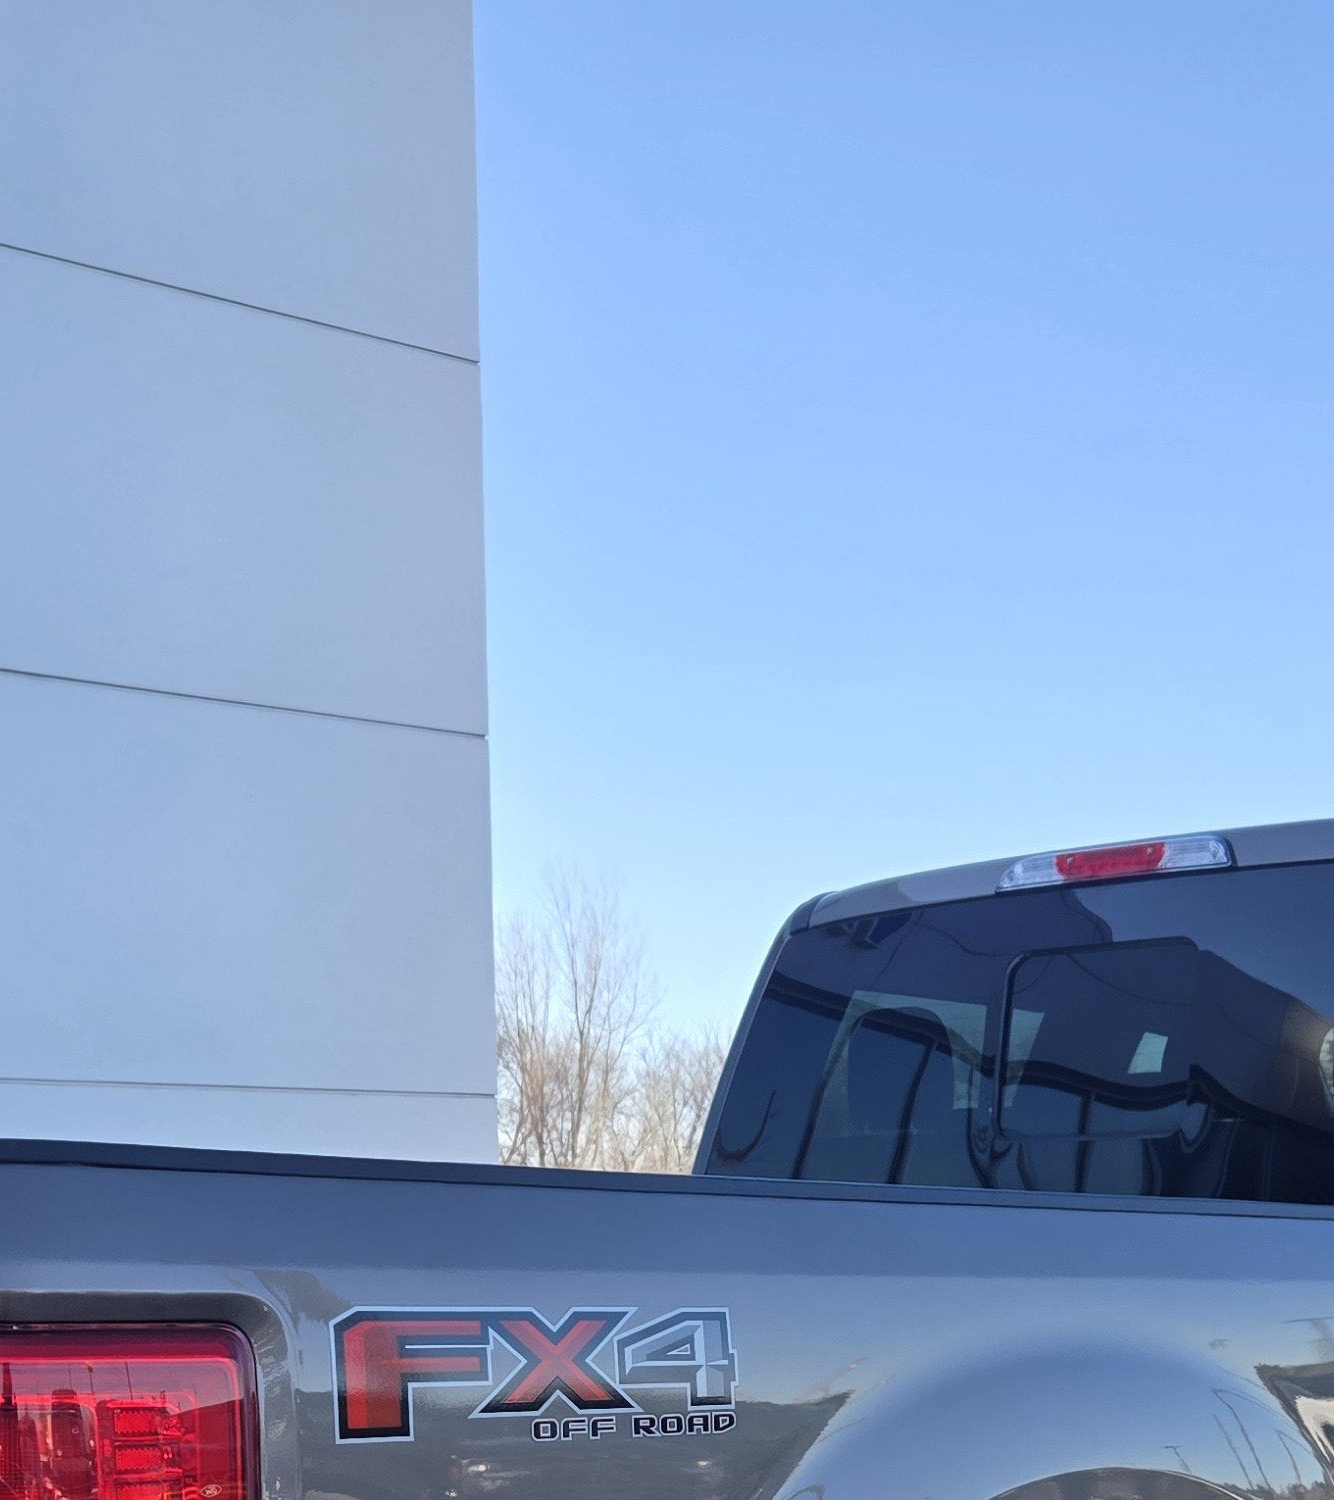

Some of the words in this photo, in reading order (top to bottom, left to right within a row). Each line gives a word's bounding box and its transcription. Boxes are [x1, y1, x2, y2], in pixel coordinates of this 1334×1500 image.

[329, 1306, 740, 1445] FX4
[531, 1416, 616, 1441] OFF
[631, 1411, 737, 1438] ROAD
